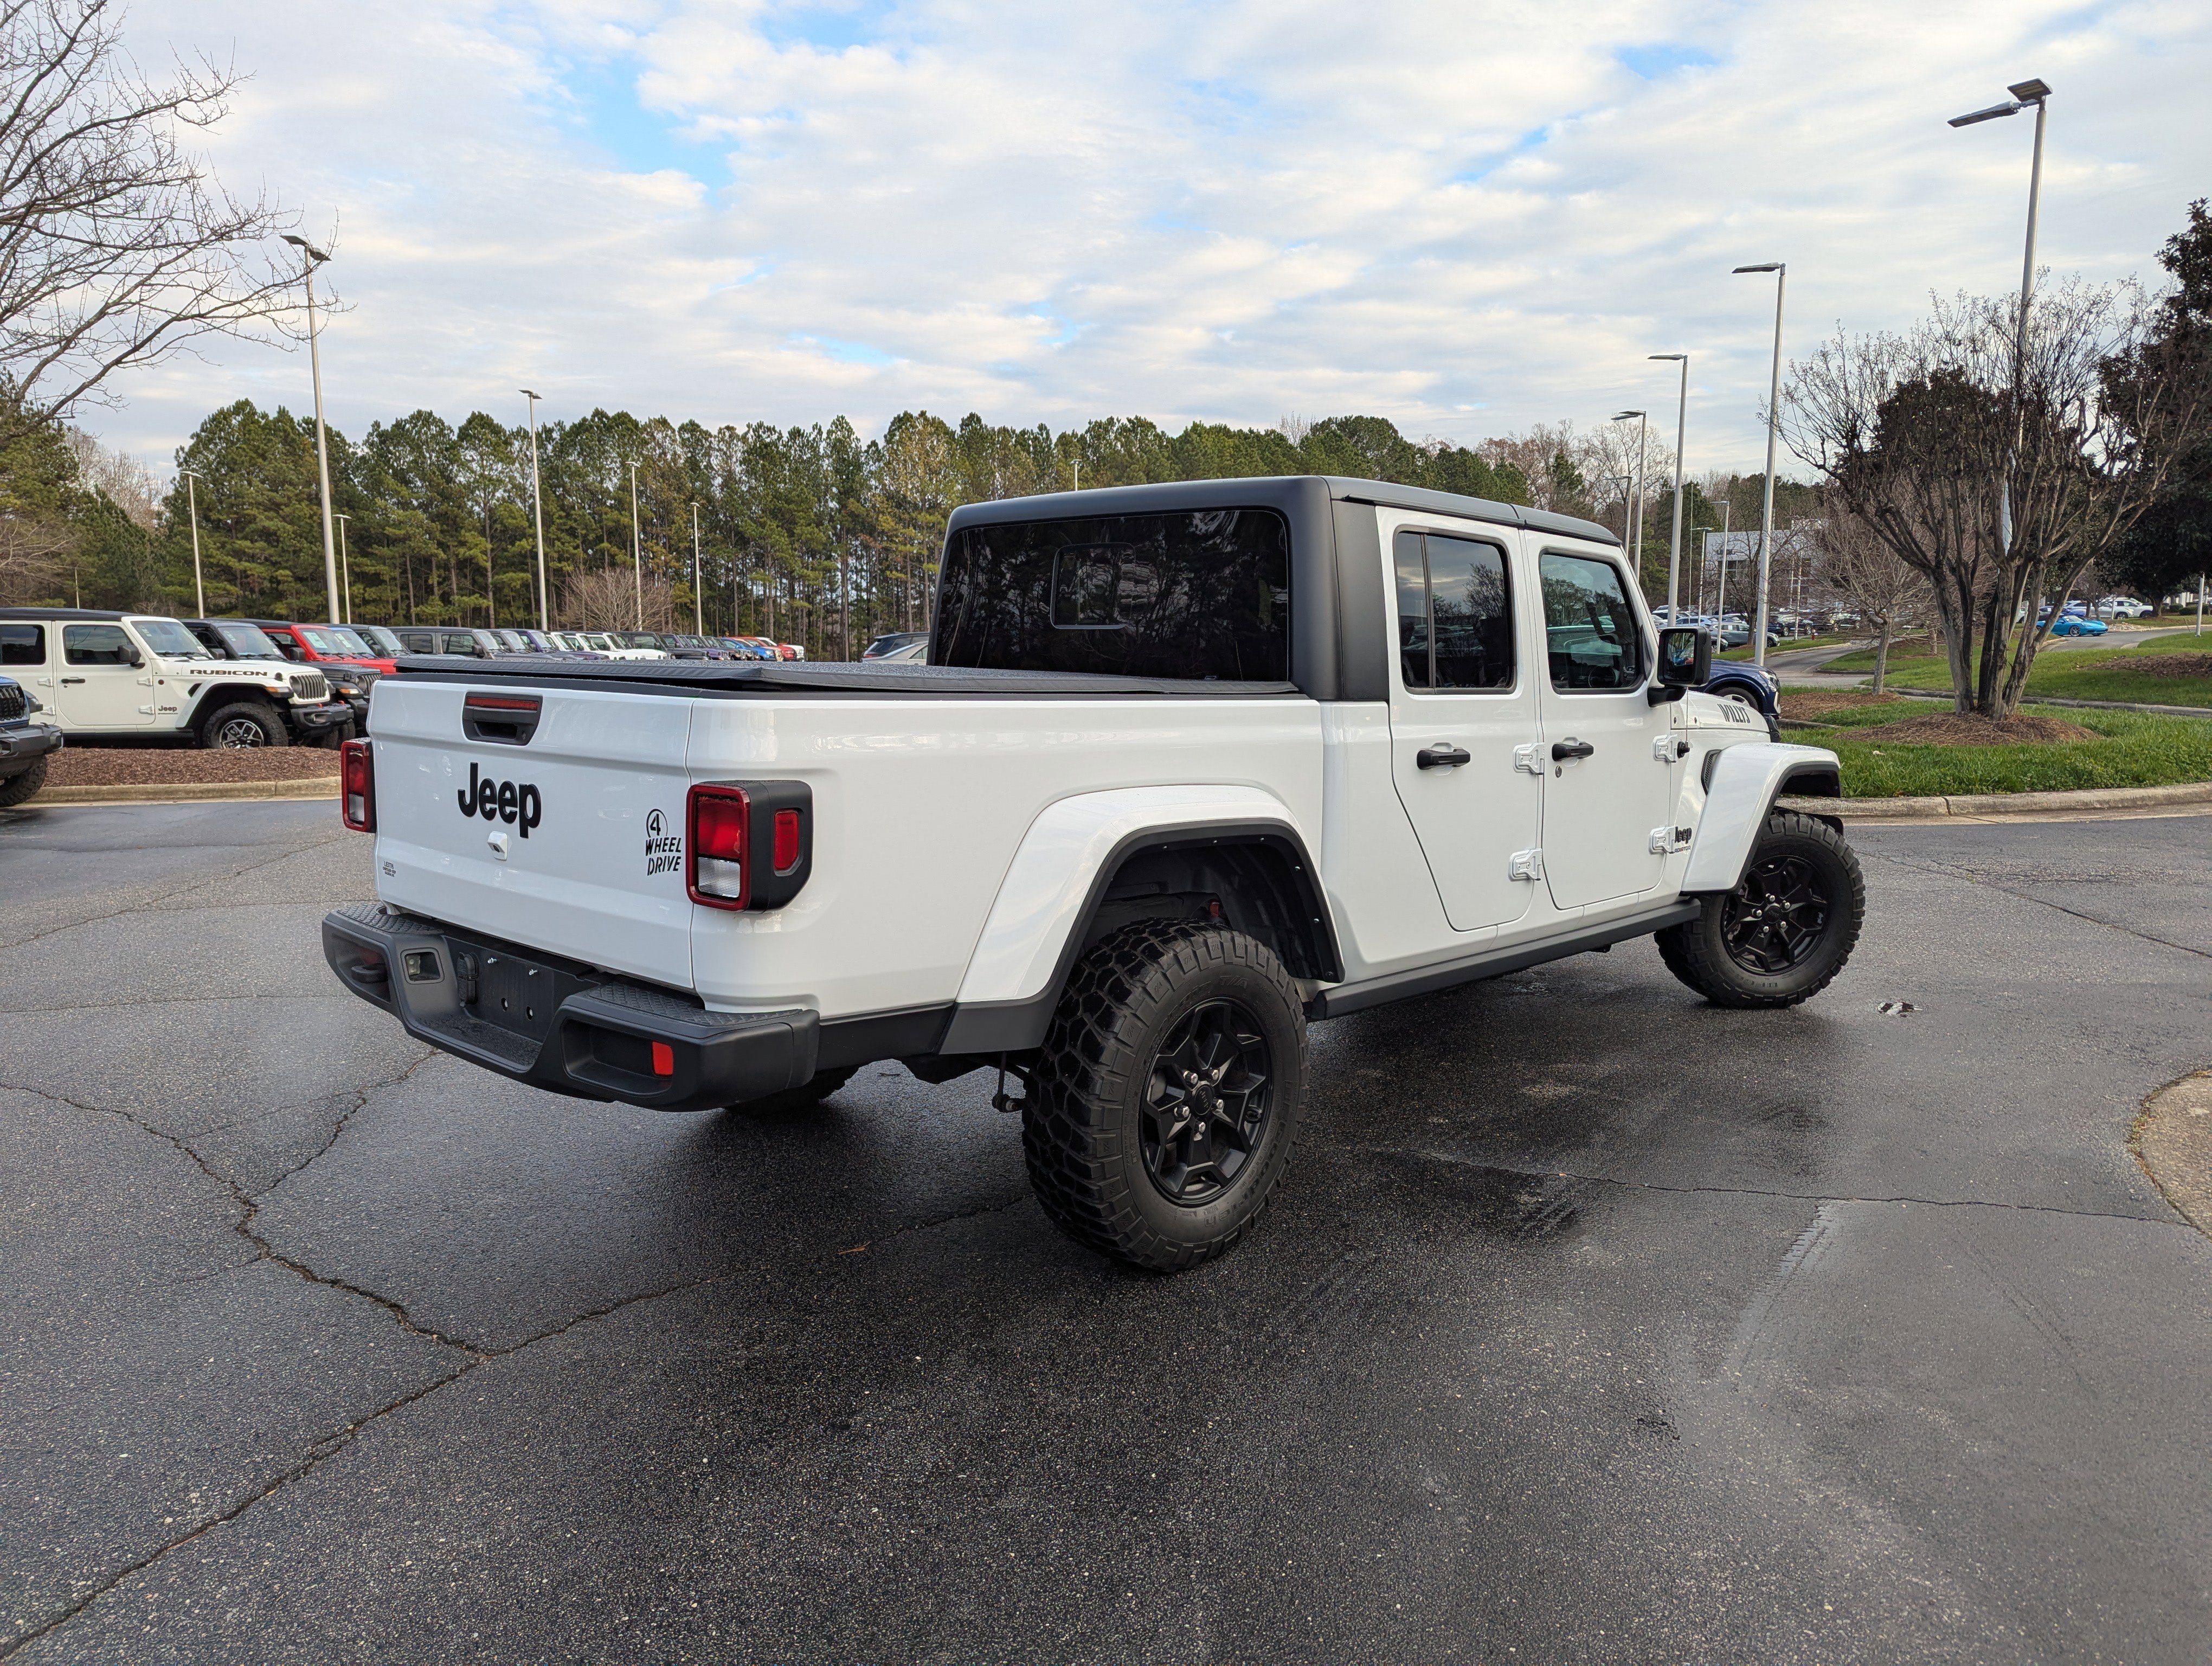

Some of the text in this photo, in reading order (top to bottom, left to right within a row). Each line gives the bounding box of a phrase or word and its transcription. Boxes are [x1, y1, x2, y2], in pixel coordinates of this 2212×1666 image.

[1716, 703, 1751, 724] WILLYS
[457, 761, 542, 839] Jeep
[650, 813, 661, 836] 4
[1674, 826, 1692, 844] Jeep
[645, 837, 681, 856] WHEEL
[647, 855, 681, 876] DRIVE
